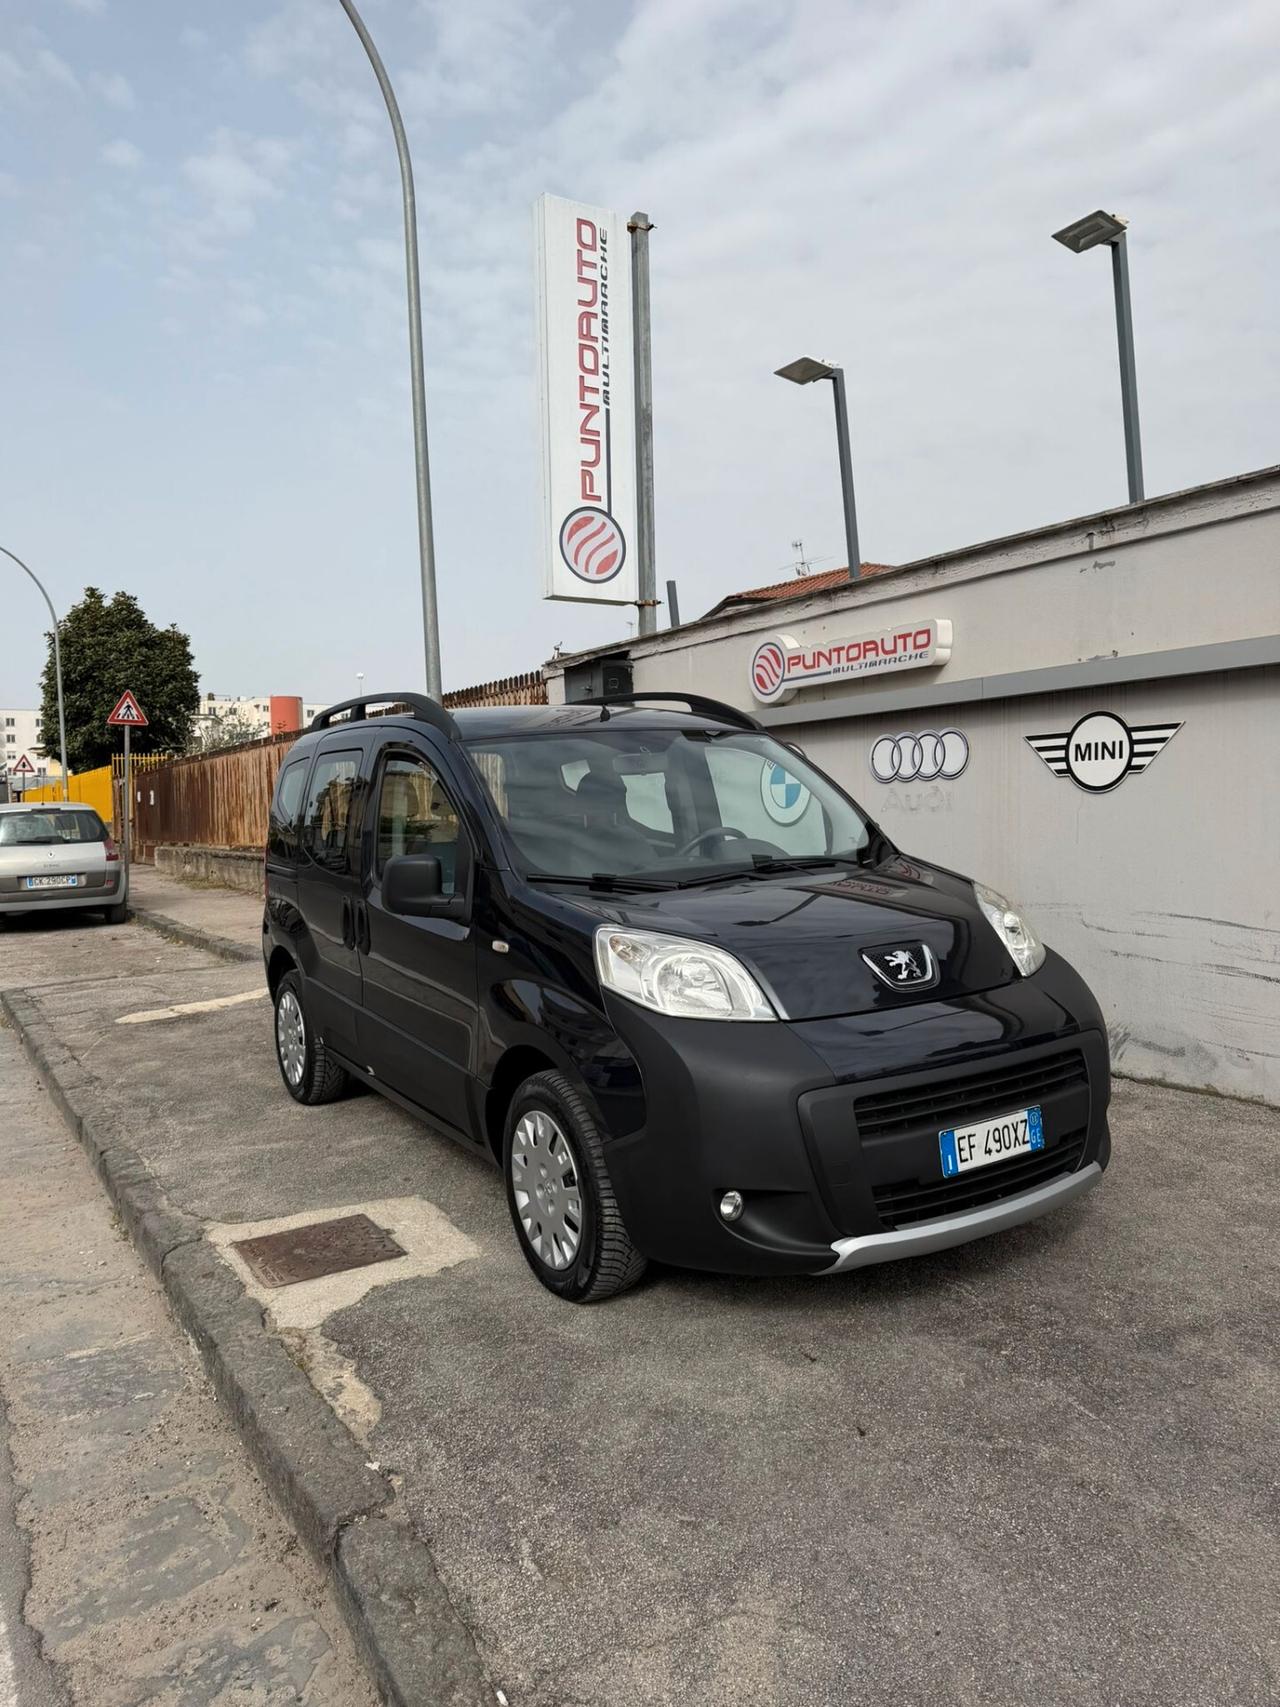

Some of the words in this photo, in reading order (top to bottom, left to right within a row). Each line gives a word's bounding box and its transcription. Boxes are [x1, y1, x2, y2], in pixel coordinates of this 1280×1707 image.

[599, 228, 609, 407] MULTIMARCHE
[576, 217, 602, 502] PUNTOAUTO
[787, 628, 931, 673] PUNTOAUTO
[832, 651, 929, 674] MULTIMARCHE
[1074, 740, 1124, 762] MINI
[957, 1133, 976, 1163] EF
[984, 1119, 1030, 1156] 490XZ
